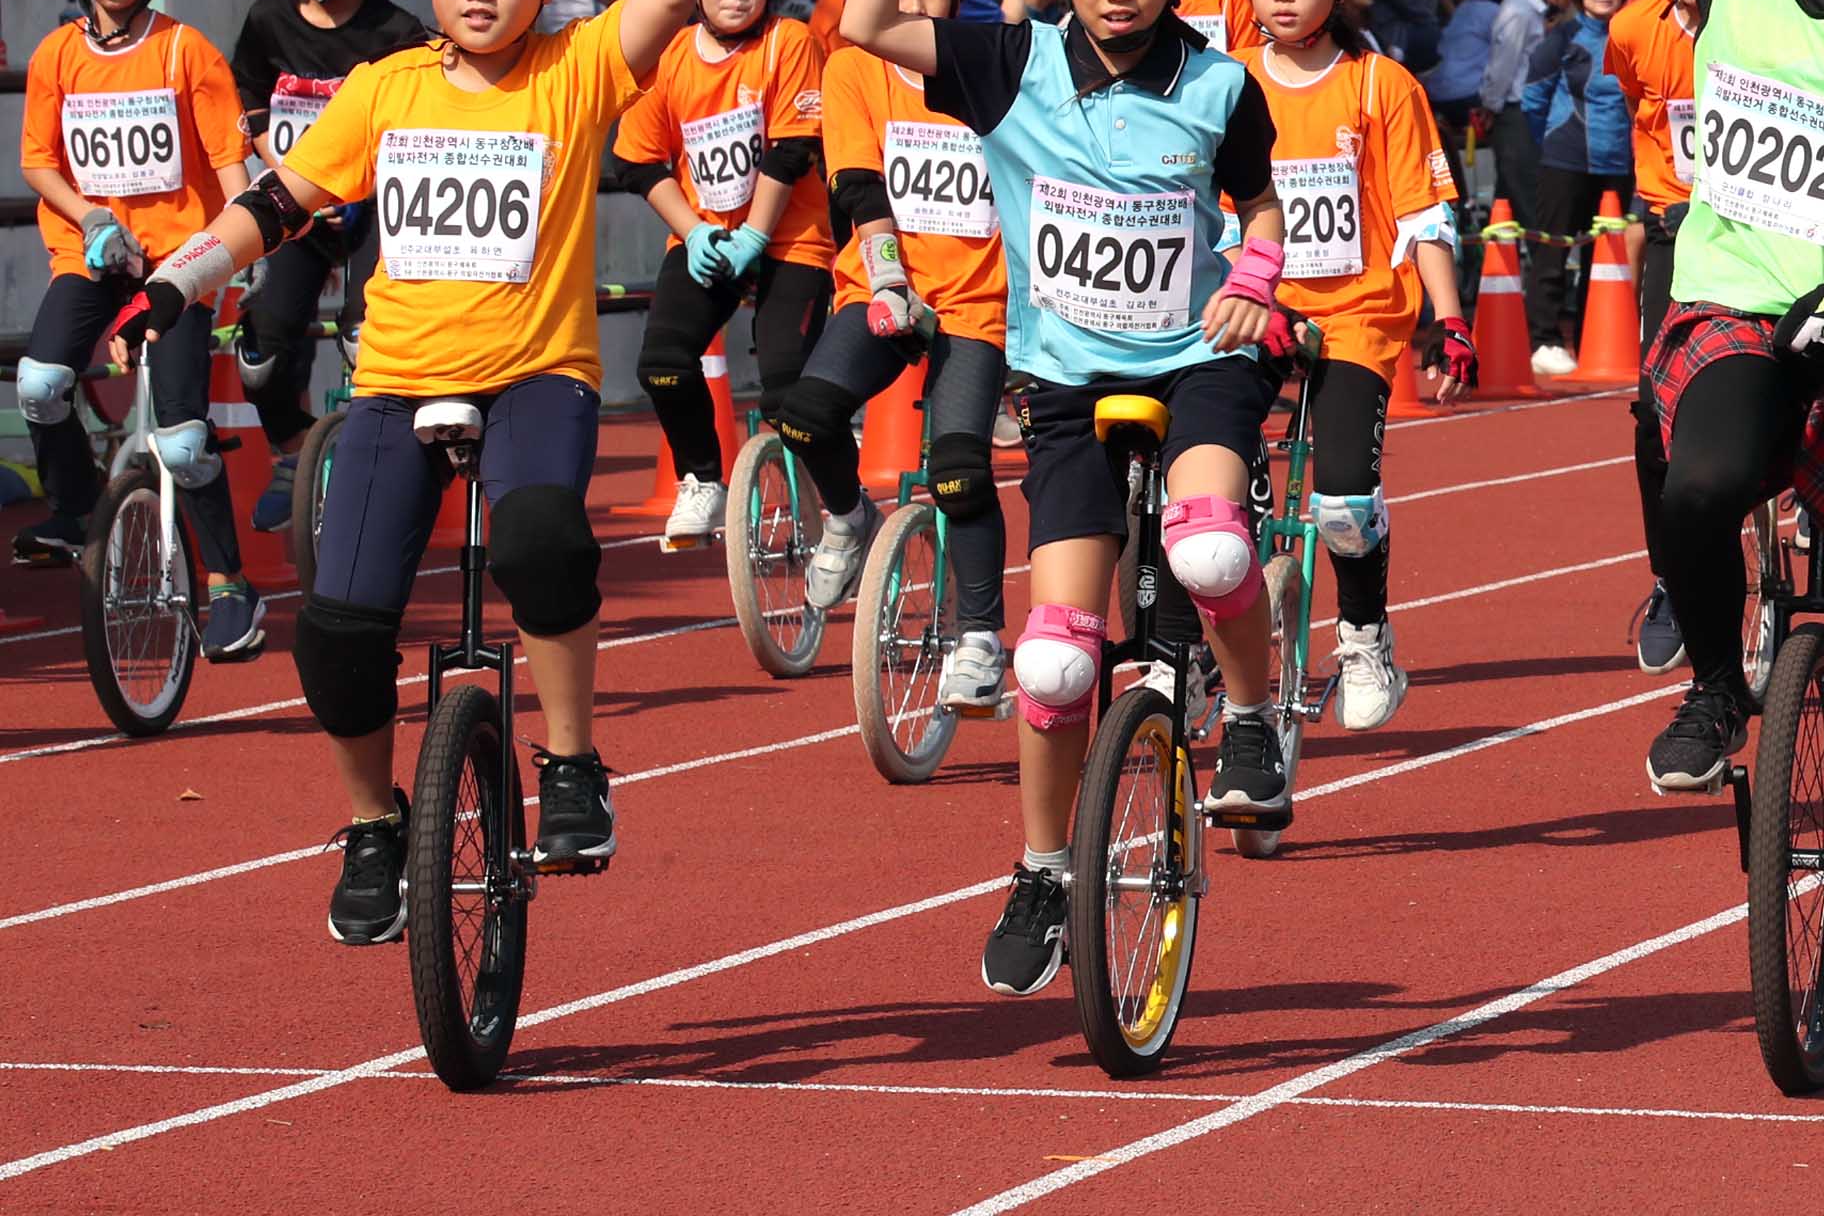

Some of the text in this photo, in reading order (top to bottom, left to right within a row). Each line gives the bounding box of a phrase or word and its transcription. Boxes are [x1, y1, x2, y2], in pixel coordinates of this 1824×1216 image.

[1714, 85, 1764, 111] 외발자전거
[1739, 78, 1793, 103] 인천광역시
[70, 122, 174, 168] 06109
[412, 135, 470, 150] 인천광역시
[941, 142, 983, 154] 종합선수권
[388, 151, 528, 167] 외발자전거 종합선수권대회
[889, 156, 995, 207] 04204
[383, 176, 530, 240] 04206
[1039, 183, 1188, 213] 제2회 인천광역시 동구청장배
[1043, 200, 1182, 227] 외발자전거 종합선수권대회
[1280, 194, 1356, 243] 203
[1037, 223, 1186, 294] 04207
